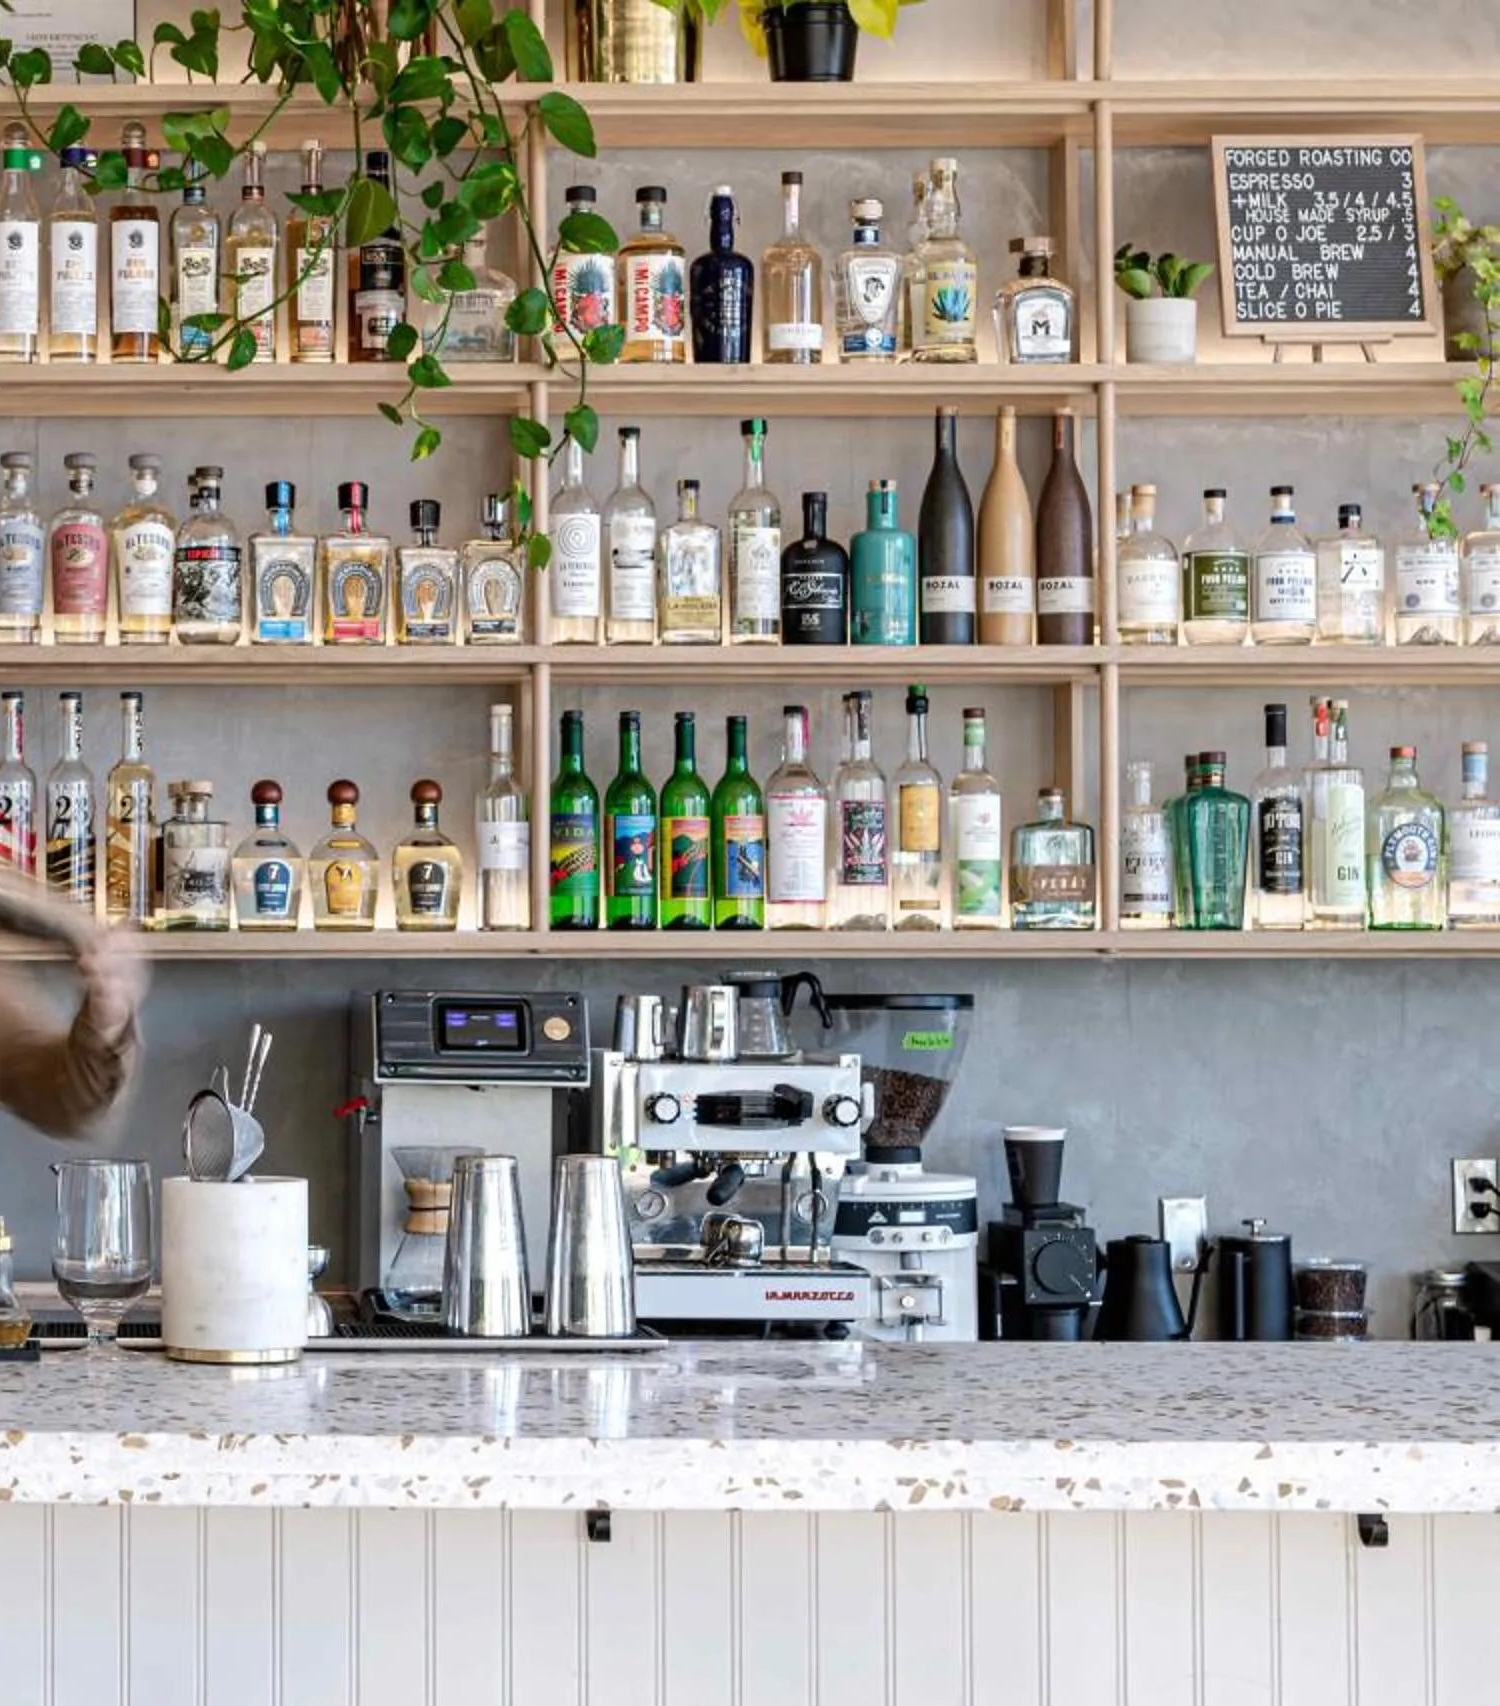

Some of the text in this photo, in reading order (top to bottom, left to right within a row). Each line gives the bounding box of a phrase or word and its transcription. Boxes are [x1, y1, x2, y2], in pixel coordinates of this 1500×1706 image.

[1226, 149, 1413, 166] FORGED ROASTING CO
[1229, 172, 1412, 190] ESPRESSO 3
[1386, 192, 1413, 208] 4.5
[1246, 208, 1291, 223] HOUSE
[1299, 207, 1335, 222] MADE
[1345, 207, 1390, 222] SYRUP
[1231, 226, 1265, 241] CUP
[1275, 226, 1287, 241] O
[1296, 226, 1328, 242] JOE
[1403, 226, 1415, 241] 3
[1232, 244, 1416, 261] MANUAL BREW 4
[1235, 264, 1418, 280] COLD BREW 4
[1236, 283, 1269, 299] TEA
[1295, 283, 1334, 299] CHAI
[1408, 282, 1419, 297] 4
[1236, 301, 1421, 319] SLICE O PIE 4
[1032, 319, 1051, 336] M
[926, 581, 961, 591] BOZAL
[989, 580, 1024, 591] BOZAL
[1337, 865, 1360, 881] GIN
